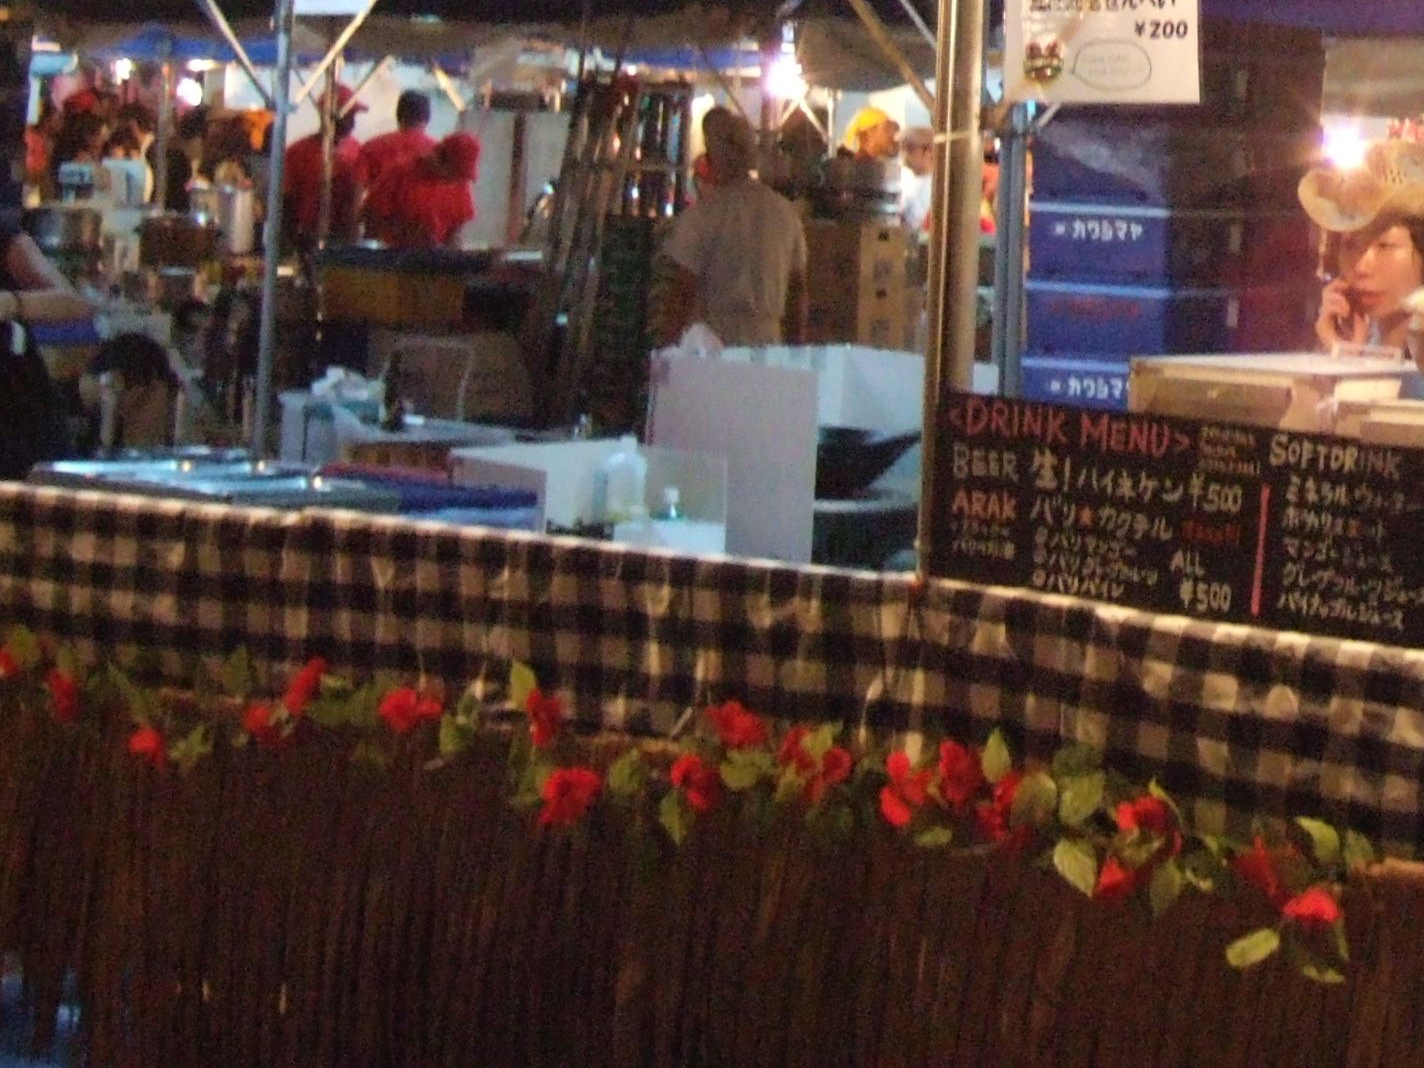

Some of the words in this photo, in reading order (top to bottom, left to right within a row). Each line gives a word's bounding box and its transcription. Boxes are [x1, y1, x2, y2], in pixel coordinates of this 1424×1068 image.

[1135, 20, 1188, 39] ¥200
[953, 442, 1018, 482] BEER
[1189, 472, 1242, 512] ¥500
[952, 489, 1017, 520] ARAK
[1170, 548, 1205, 576] ALL
[1179, 577, 1232, 613] ¥500
